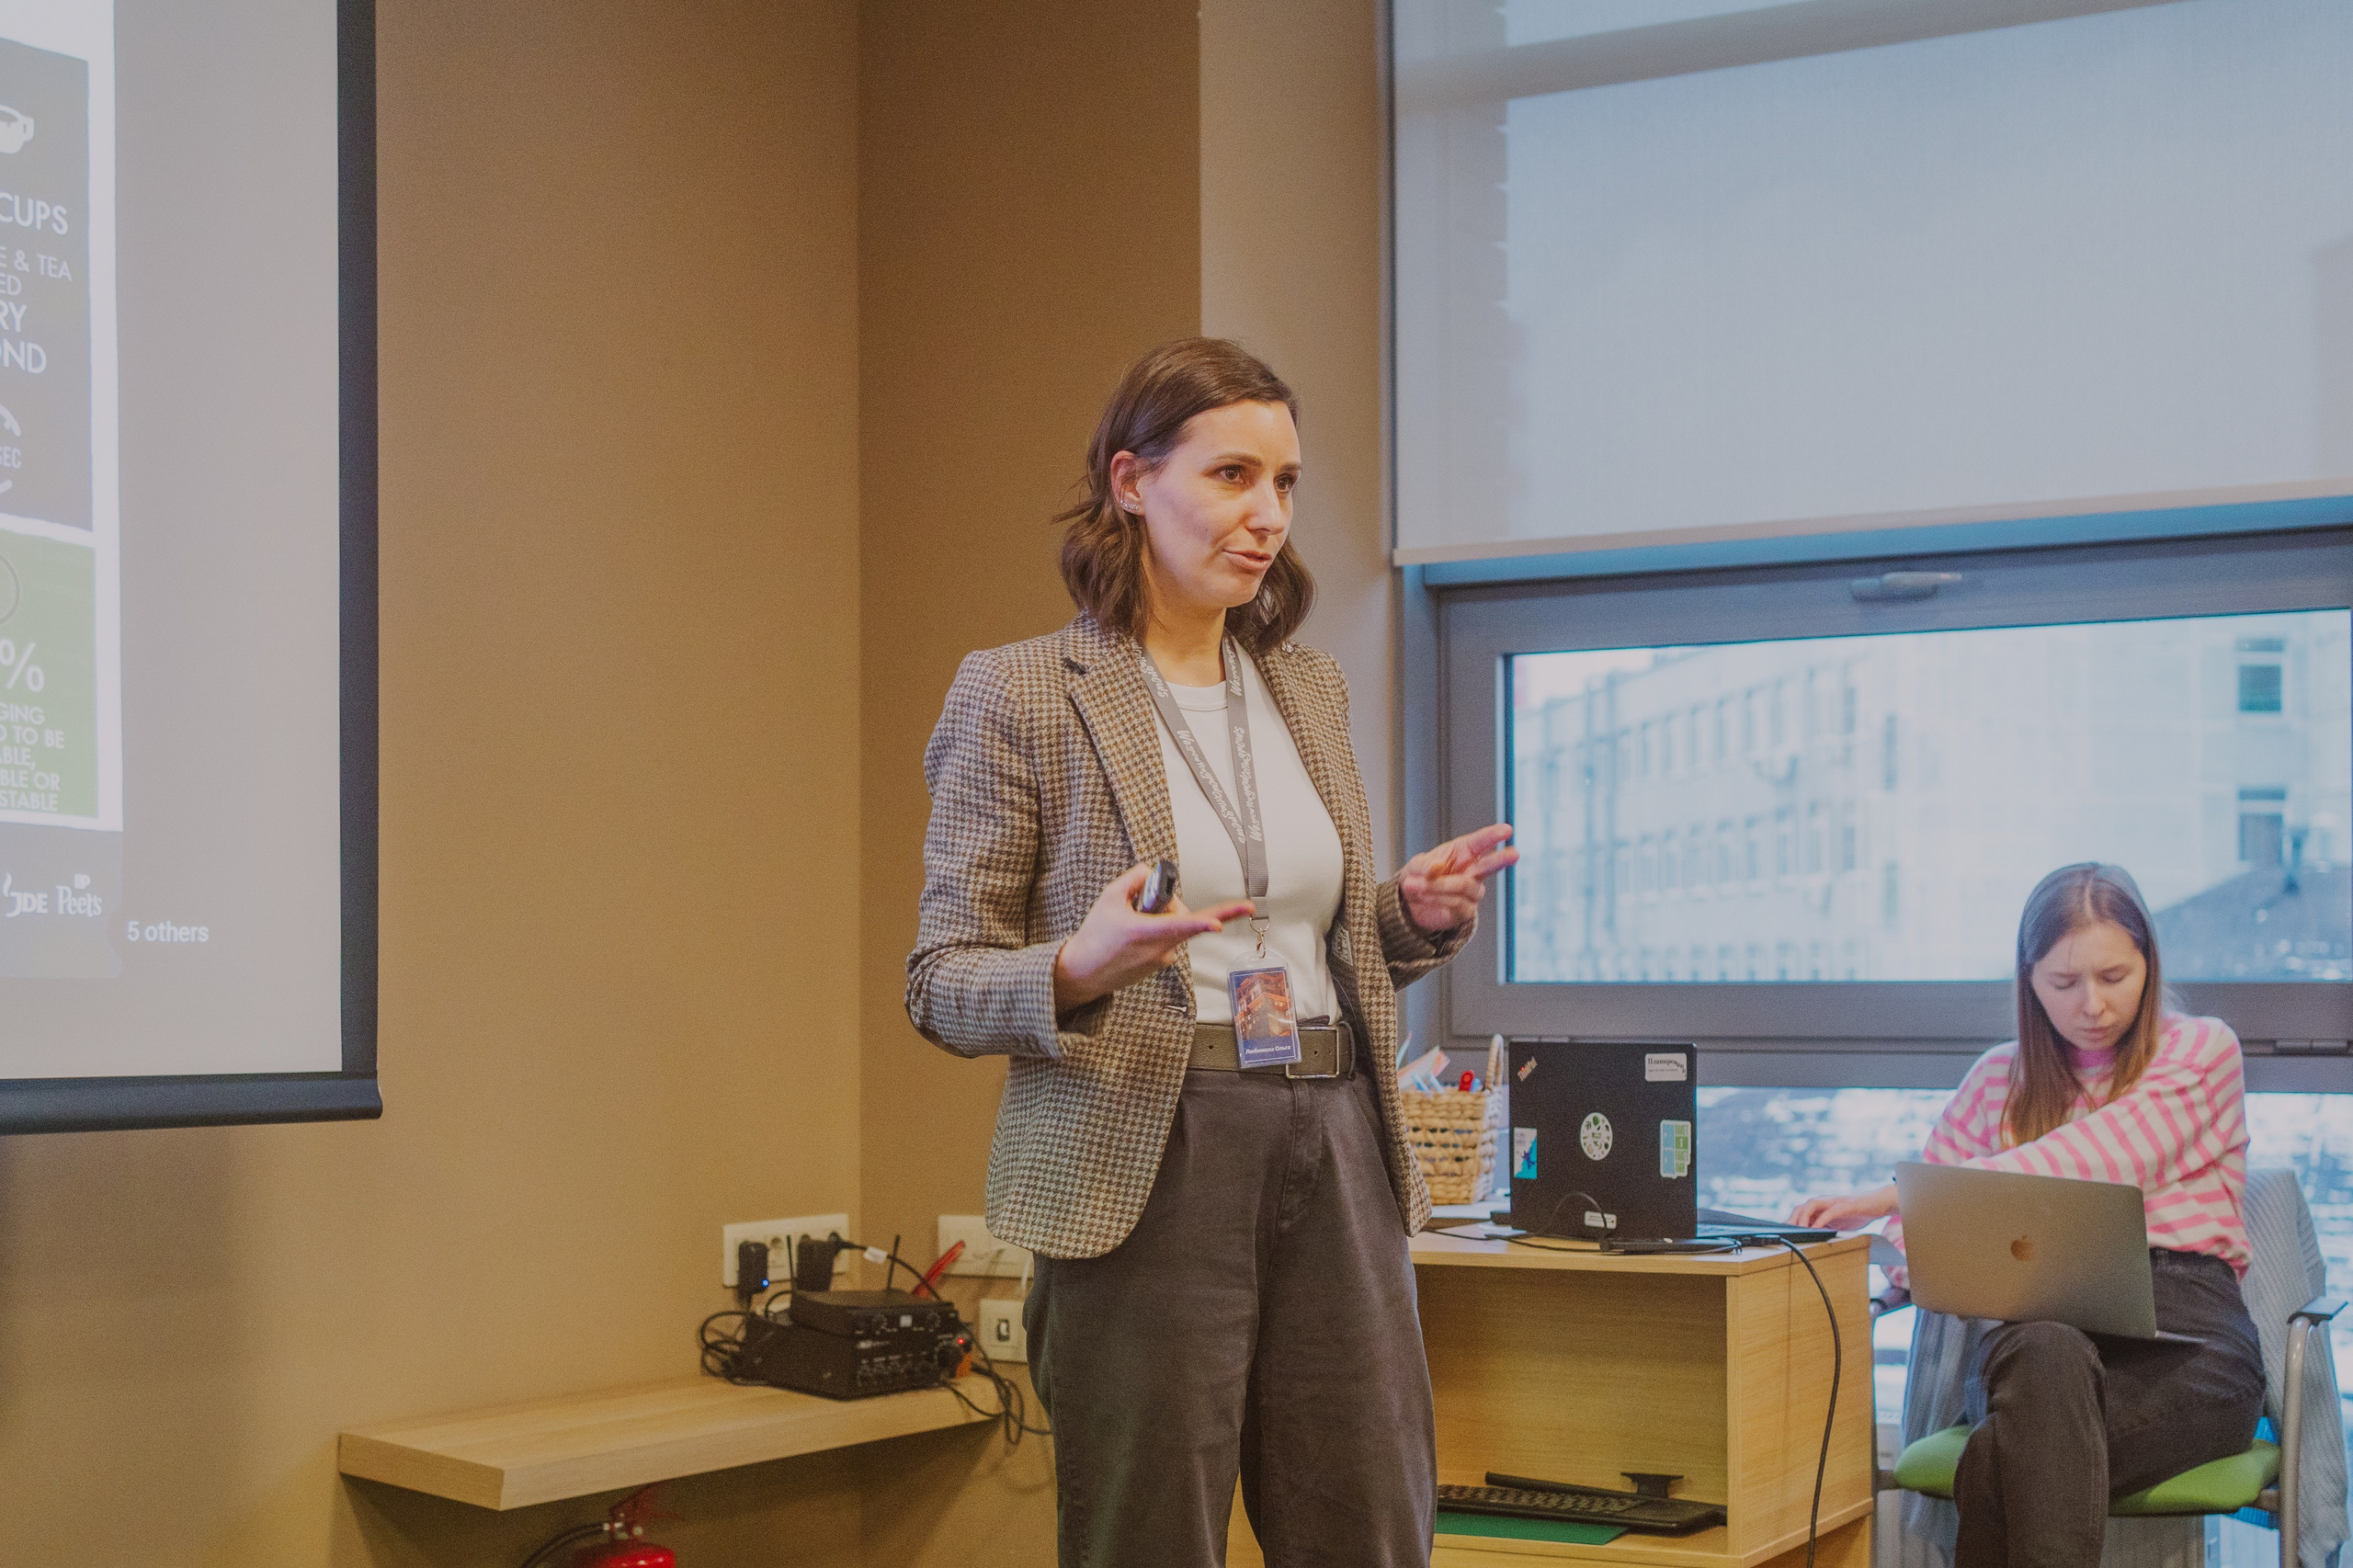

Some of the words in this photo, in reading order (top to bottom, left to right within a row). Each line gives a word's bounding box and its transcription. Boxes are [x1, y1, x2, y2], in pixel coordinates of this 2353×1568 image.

[0, 192, 68, 235] CUPS
[14, 250, 30, 273] &
[37, 253, 73, 282] TEA
[0, 337, 47, 374] ND
[12, 725, 39, 745] TO
[45, 728, 65, 749] BE
[34, 771, 61, 791] OR
[5, 891, 49, 917] JDE
[128, 921, 140, 942] 5
[144, 920, 210, 942] others
